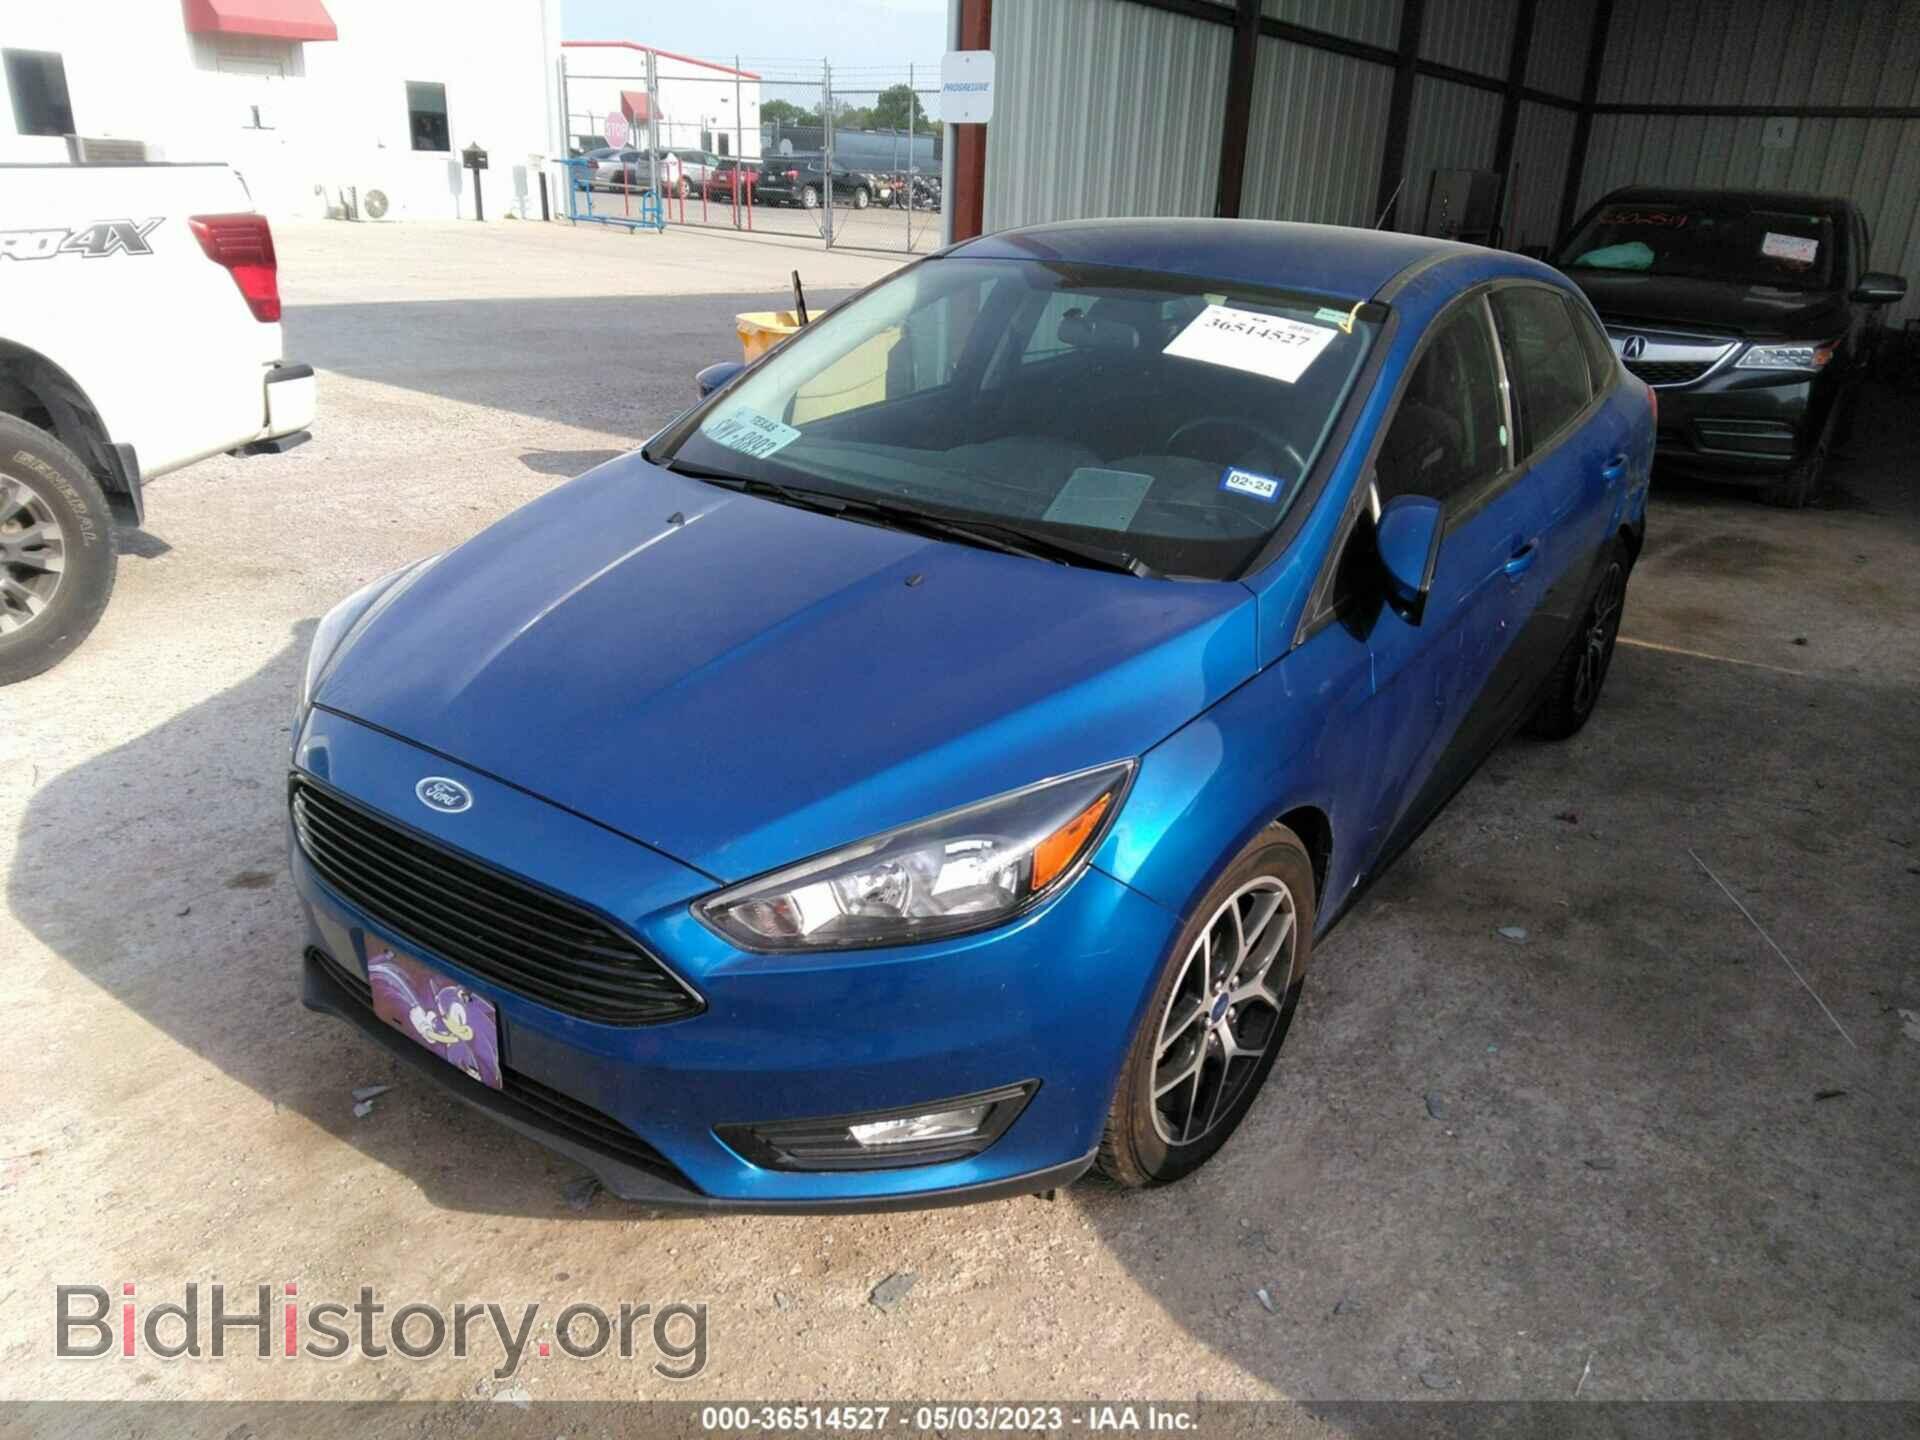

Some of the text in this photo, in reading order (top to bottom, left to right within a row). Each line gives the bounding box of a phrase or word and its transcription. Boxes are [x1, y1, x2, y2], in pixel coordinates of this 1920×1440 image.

[943, 82, 991, 92] PROGRESSIVE
[607, 122, 627, 137] STOP
[1204, 317, 1311, 347] 36514527
[1229, 473, 1275, 493] 02-24
[12, 449, 97, 547] GENERAL
[425, 782, 462, 807] Ford
